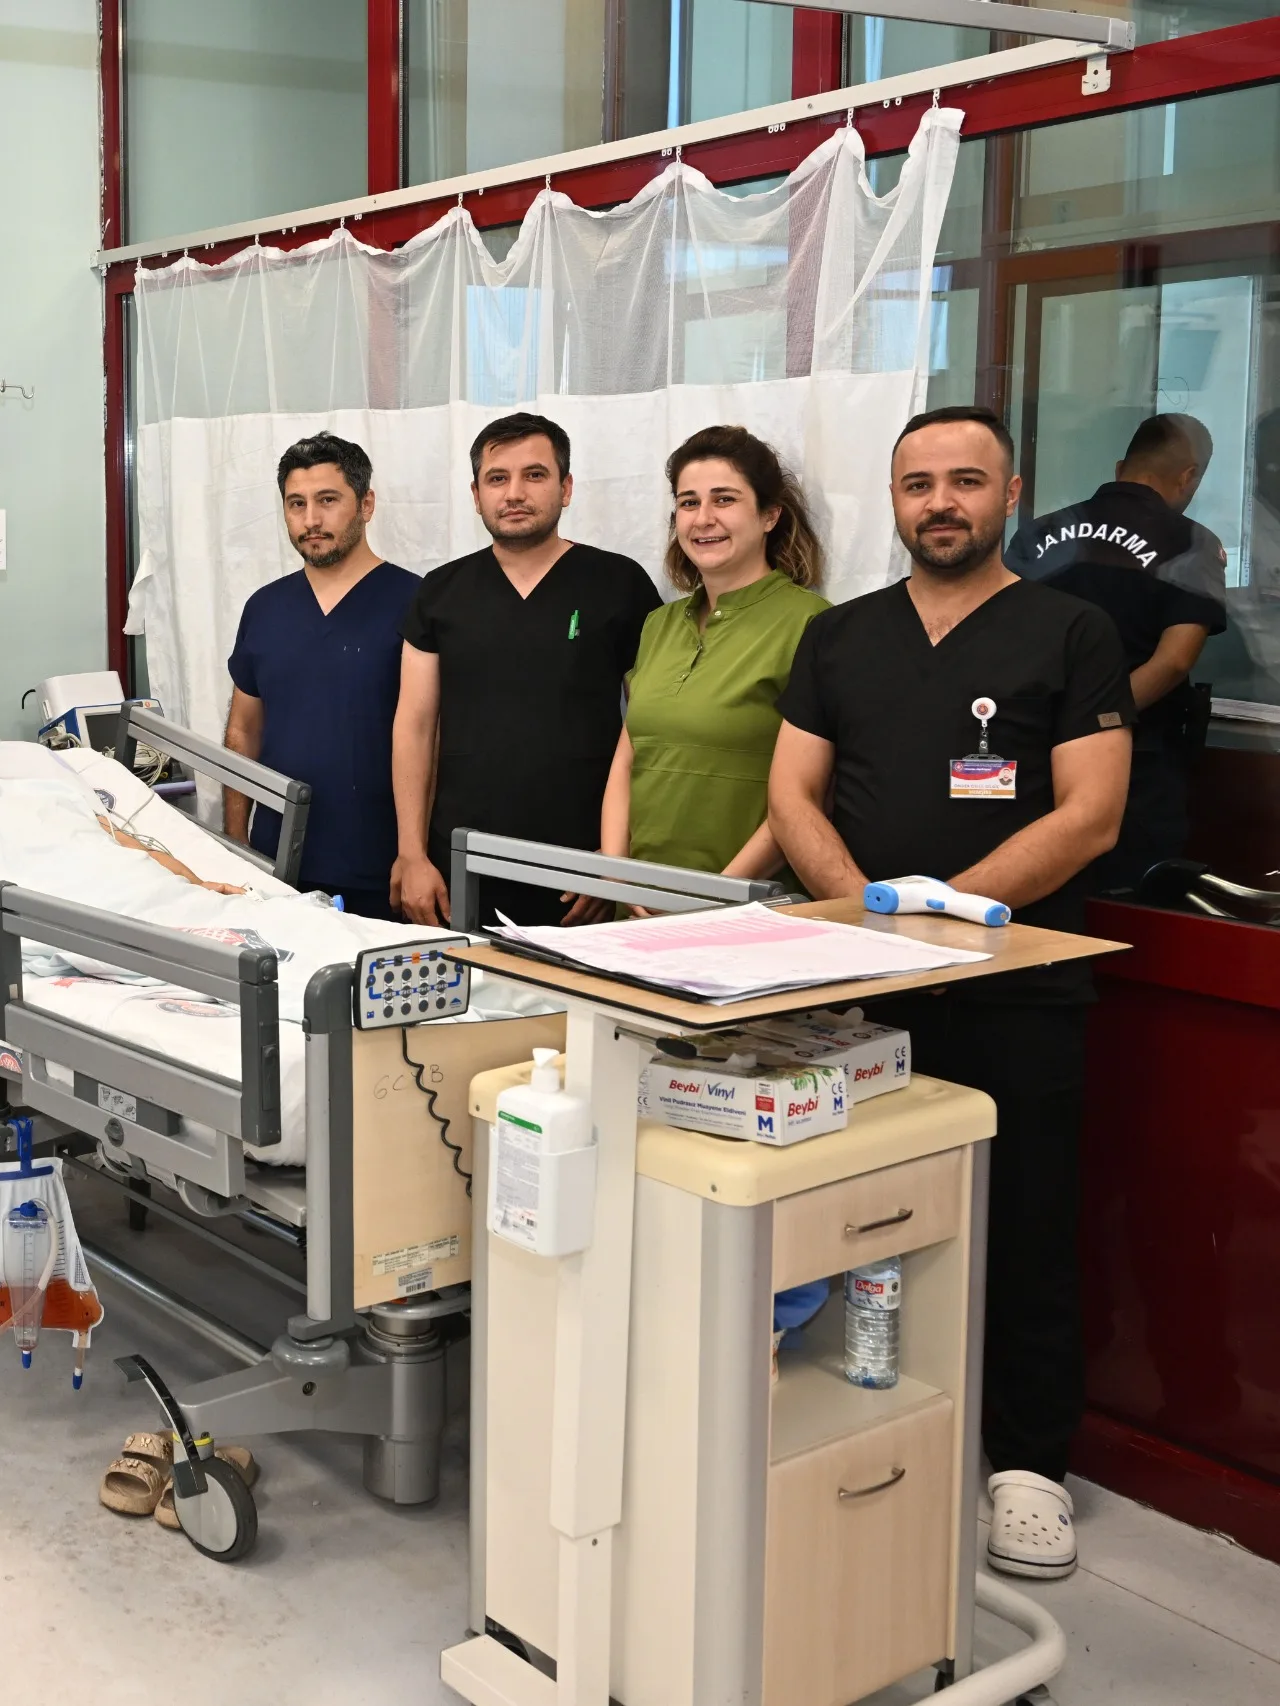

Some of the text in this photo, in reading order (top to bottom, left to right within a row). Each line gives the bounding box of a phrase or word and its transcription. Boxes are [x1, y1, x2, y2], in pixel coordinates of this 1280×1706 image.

[1036, 522, 1158, 568] JANDARMA
[854, 1061, 885, 1082] Beybi
[896, 1060, 905, 1073] M
[669, 1079, 735, 1101] Beybi Vinyl
[787, 1096, 819, 1118] Beybi
[833, 1096, 843, 1111] M
[758, 1114, 774, 1133] M
